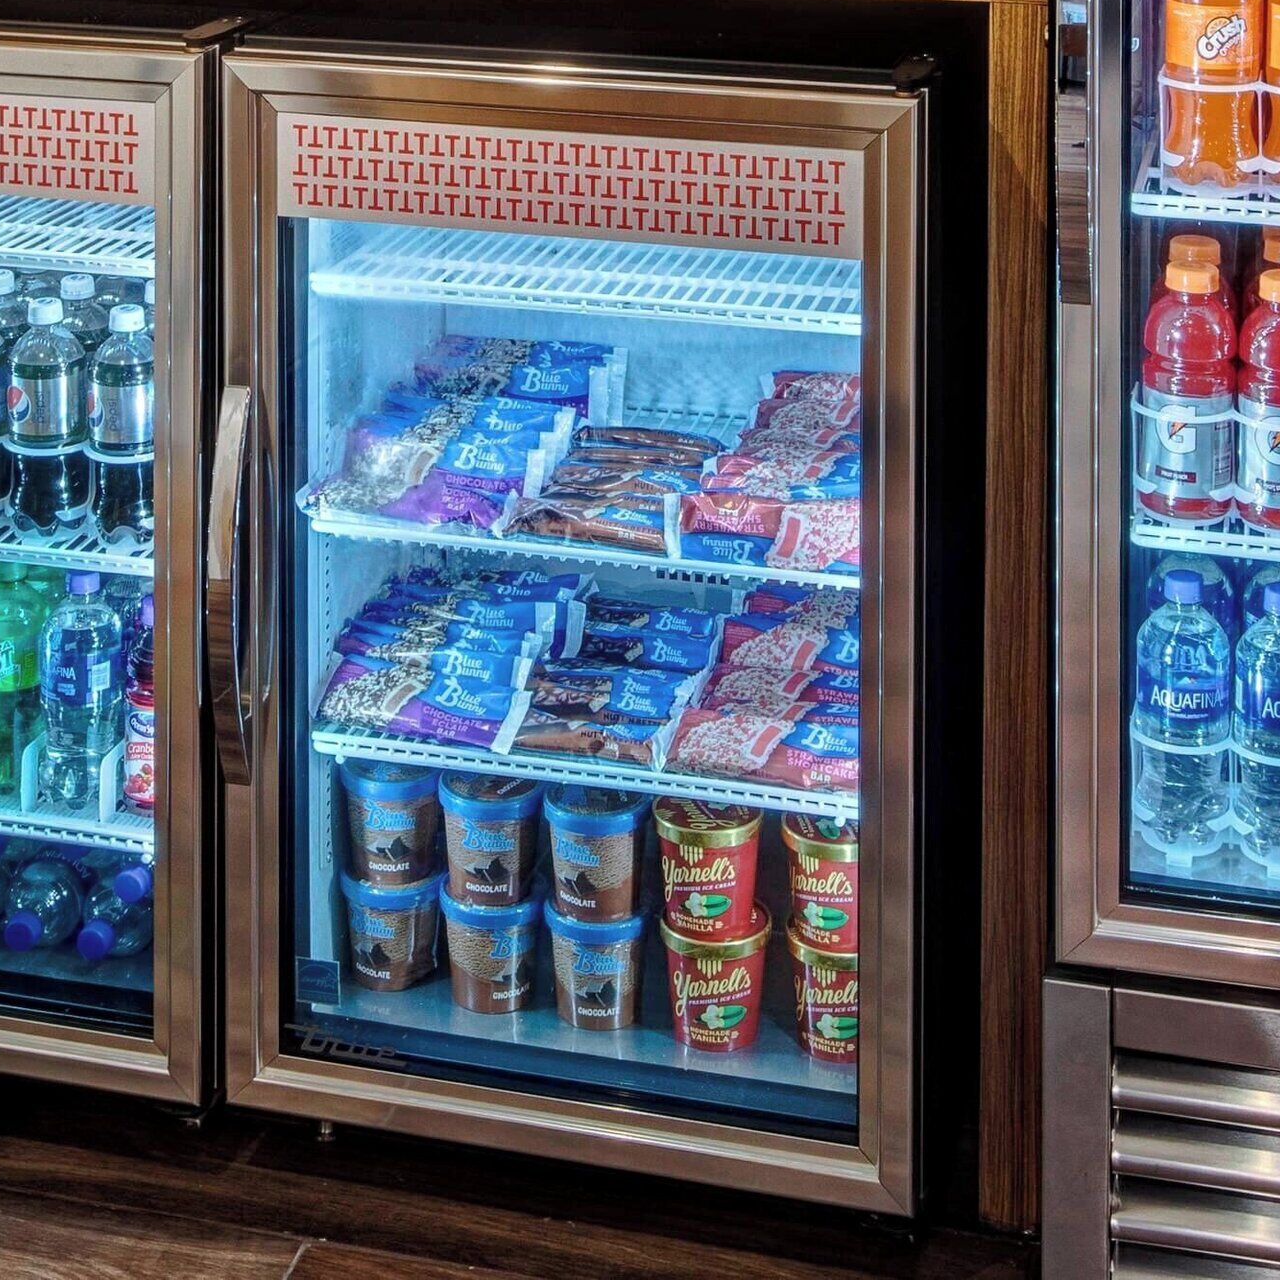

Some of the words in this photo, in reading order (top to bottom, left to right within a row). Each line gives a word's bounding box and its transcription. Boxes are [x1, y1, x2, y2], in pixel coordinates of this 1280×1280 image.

[1197, 15, 1246, 60] Crush
[446, 474, 506, 491] CHOCOLATE
[1150, 684, 1223, 712] AQUAFINA
[423, 705, 481, 728] CHOCOLATE
[431, 719, 468, 733] ECLAIR
[436, 727, 456, 738] BAR
[810, 771, 832, 783] BAR
[368, 860, 410, 872] CHOCOLATE
[662, 855, 736, 902] Yarnell's
[465, 882, 508, 893] CHOCOLATE
[560, 890, 596, 909] CHOCOLATE
[675, 912, 717, 926] HOMEMADE
[677, 919, 713, 933] VANILLA
[674, 966, 752, 1017] Yarnell's
[688, 997, 718, 1005] PREMIUM
[720, 994, 730, 1003] ICE
[577, 1006, 620, 1017] CHOCOLATE
[689, 1026, 731, 1038] HOMEMADE
[691, 1032, 730, 1044] VANILLA
